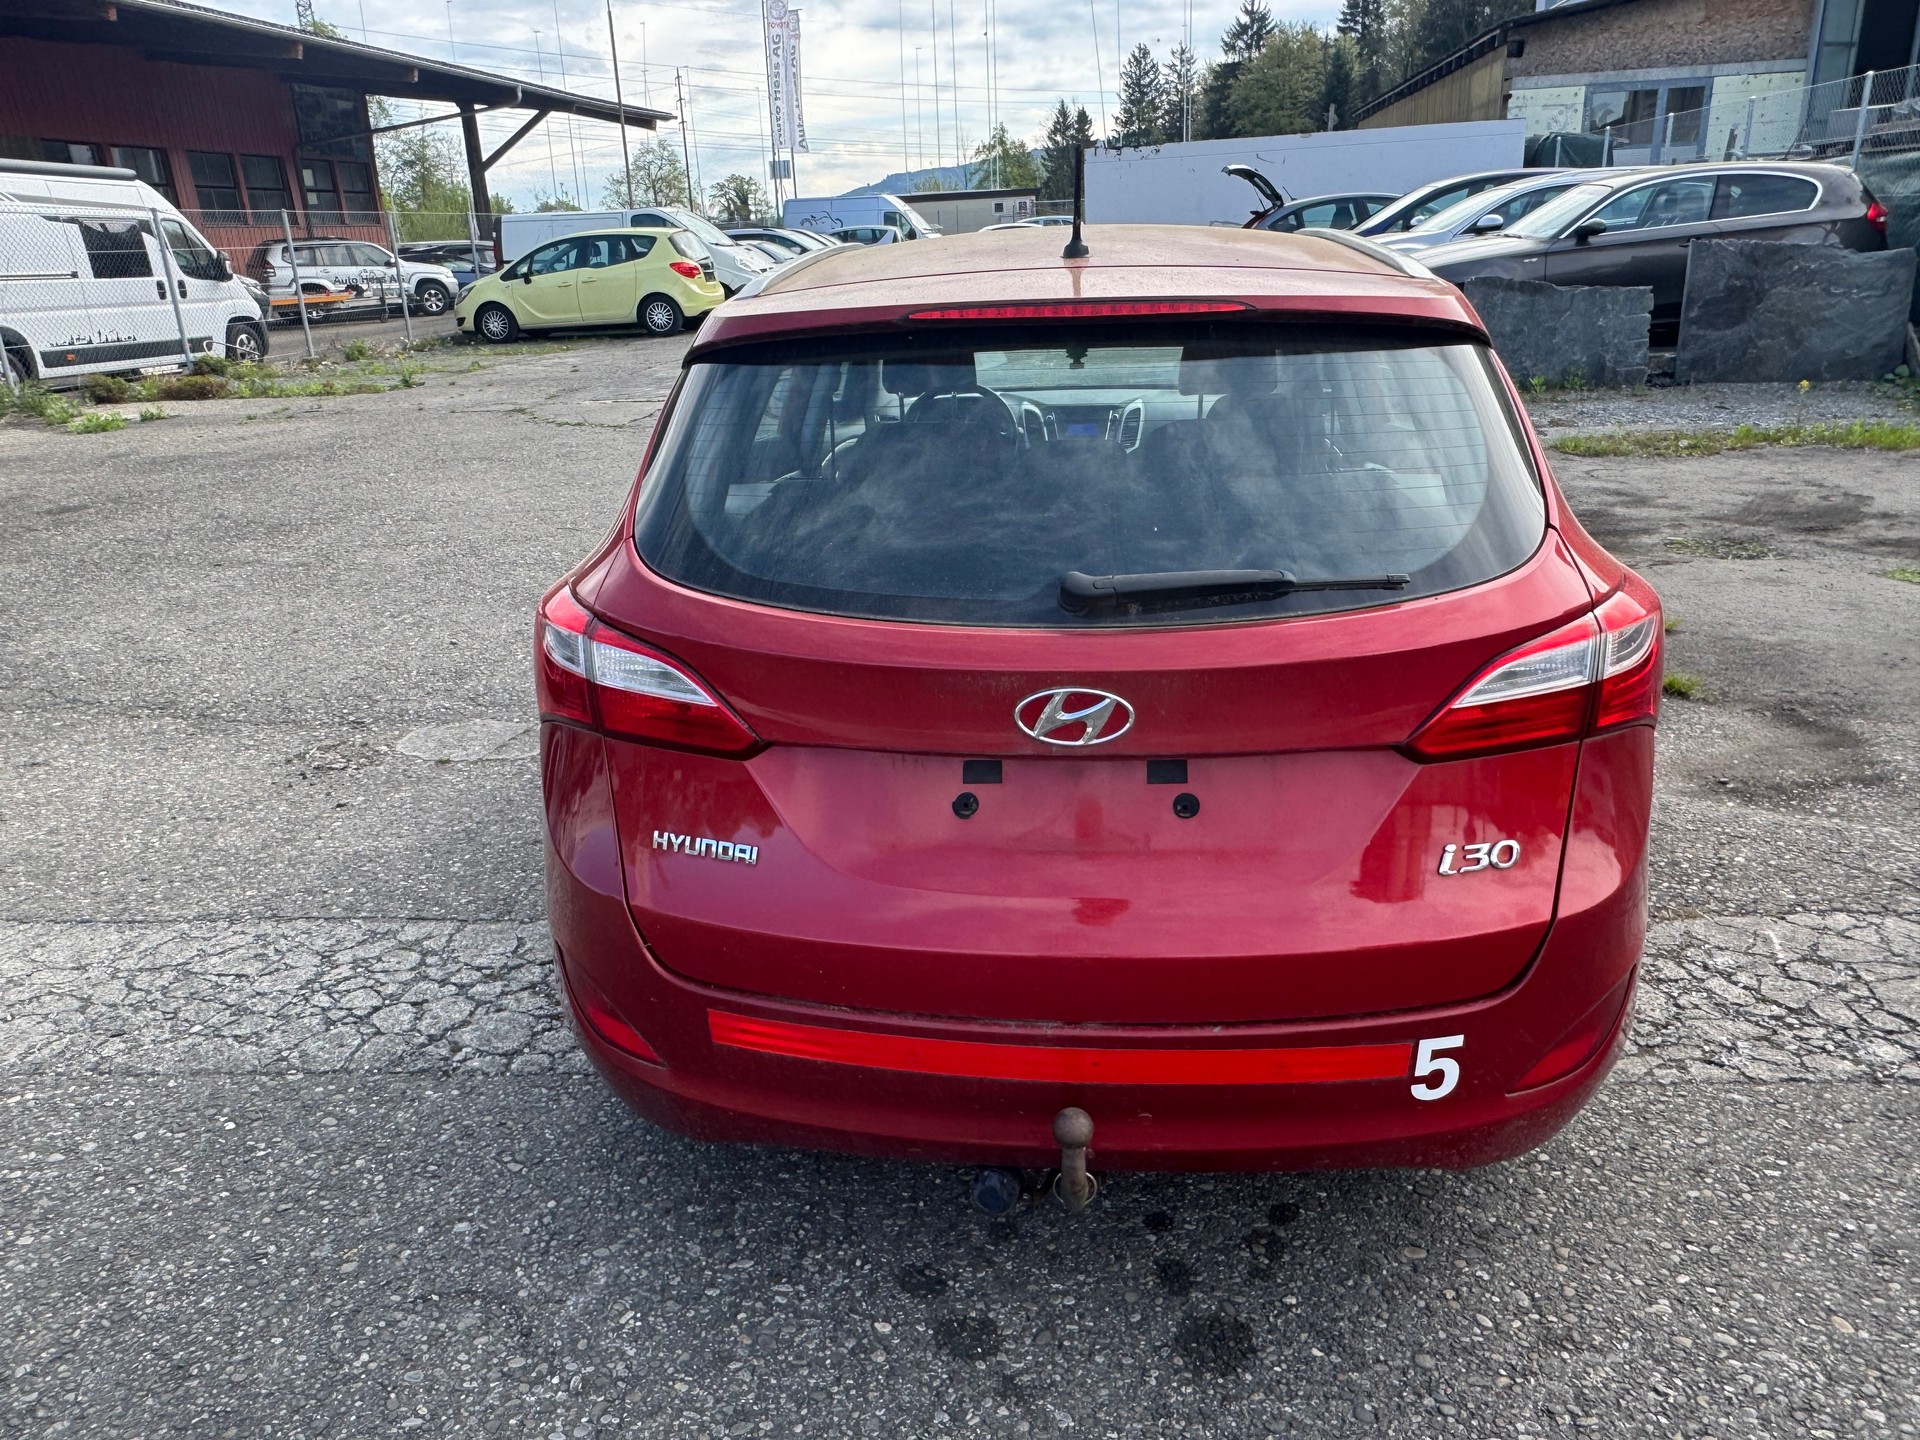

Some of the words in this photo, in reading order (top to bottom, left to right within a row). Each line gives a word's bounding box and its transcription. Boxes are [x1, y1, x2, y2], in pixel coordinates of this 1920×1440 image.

[771, 33, 782, 59] AG
[333, 276, 358, 285] Auto
[652, 830, 759, 865] HYUNDAI
[1438, 839, 1520, 875] i30
[1410, 1034, 1465, 1101] 5
